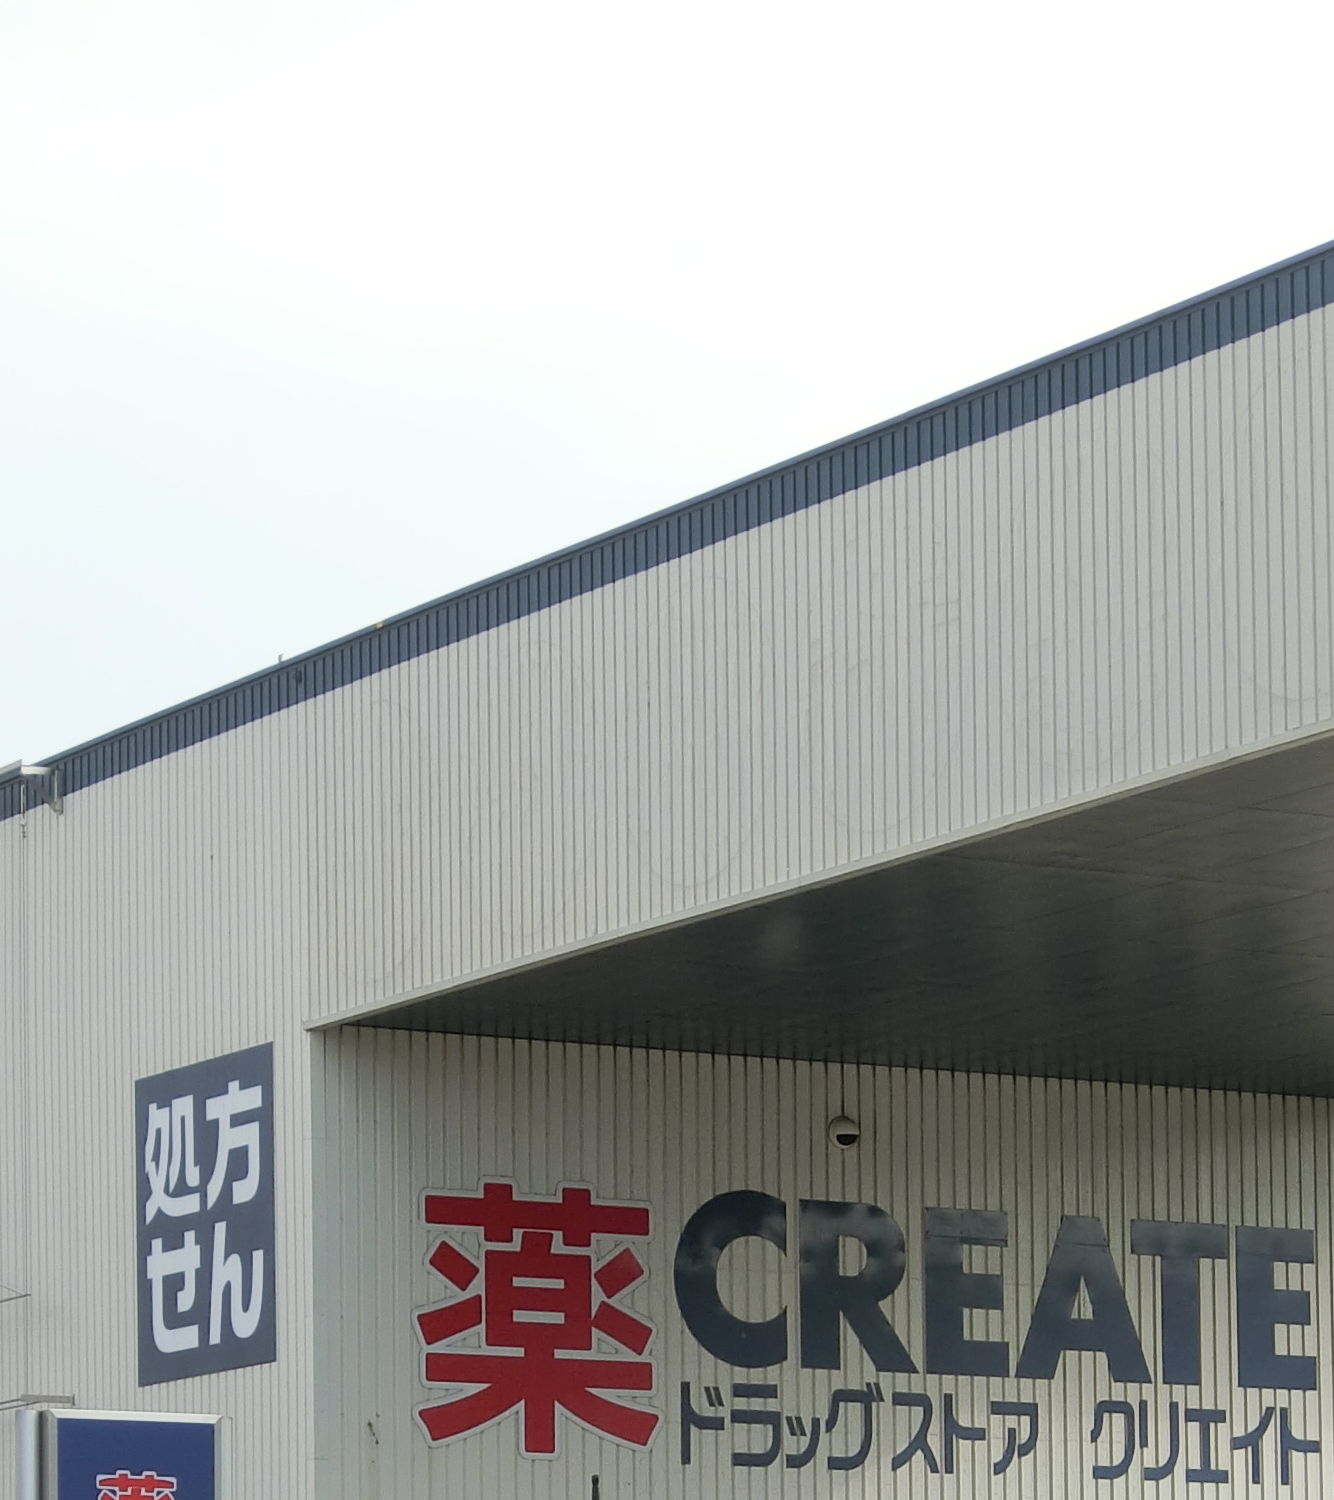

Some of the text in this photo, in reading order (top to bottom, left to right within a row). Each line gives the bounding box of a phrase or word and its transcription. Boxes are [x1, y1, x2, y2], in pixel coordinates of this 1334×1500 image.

[145, 1080, 262, 1226] 処方
[147, 1221, 264, 1353] せん
[411, 1175, 1316, 1461] 薬 CREATE
[680, 1382, 1321, 1485] ドラッグストア クリエイト
